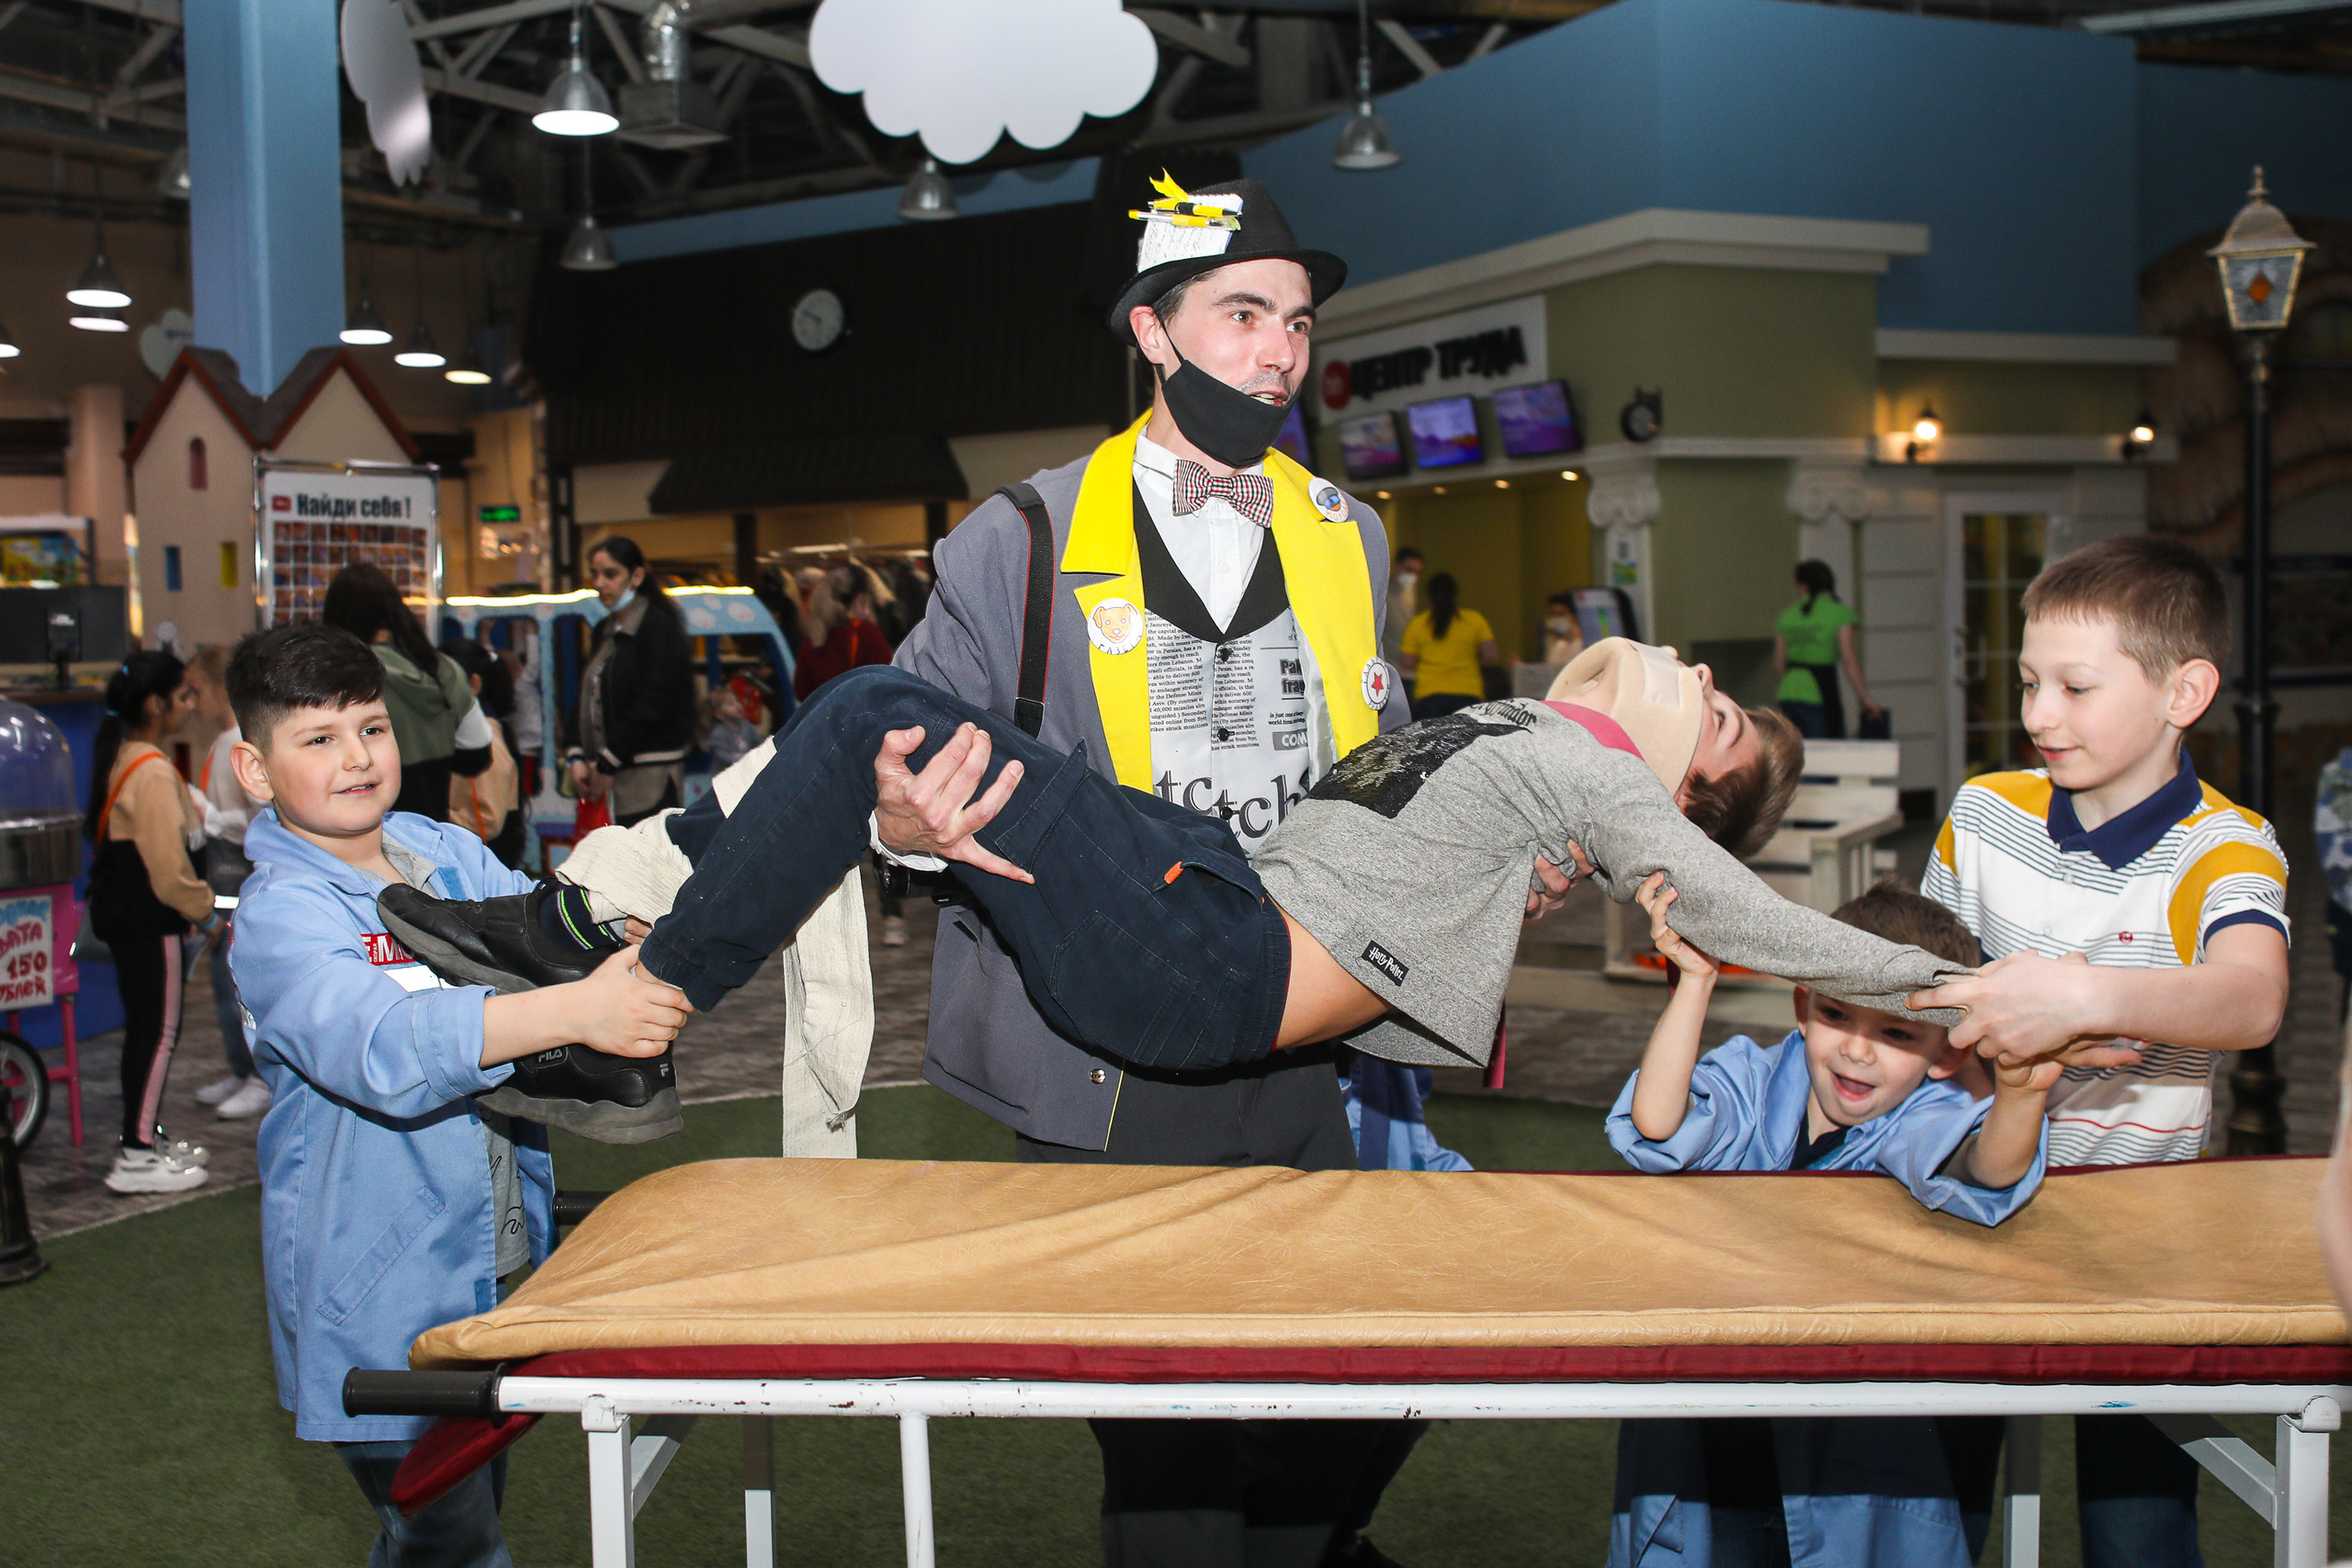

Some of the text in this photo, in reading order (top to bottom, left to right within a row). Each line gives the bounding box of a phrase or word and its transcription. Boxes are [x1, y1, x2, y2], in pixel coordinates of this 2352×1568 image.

[297, 492, 357, 522] Найди
[360, 495, 402, 518] себя
[6, 950, 48, 980] 150
[1369, 947, 1403, 981] Harry Potter
[538, 1048, 563, 1063] FILA
